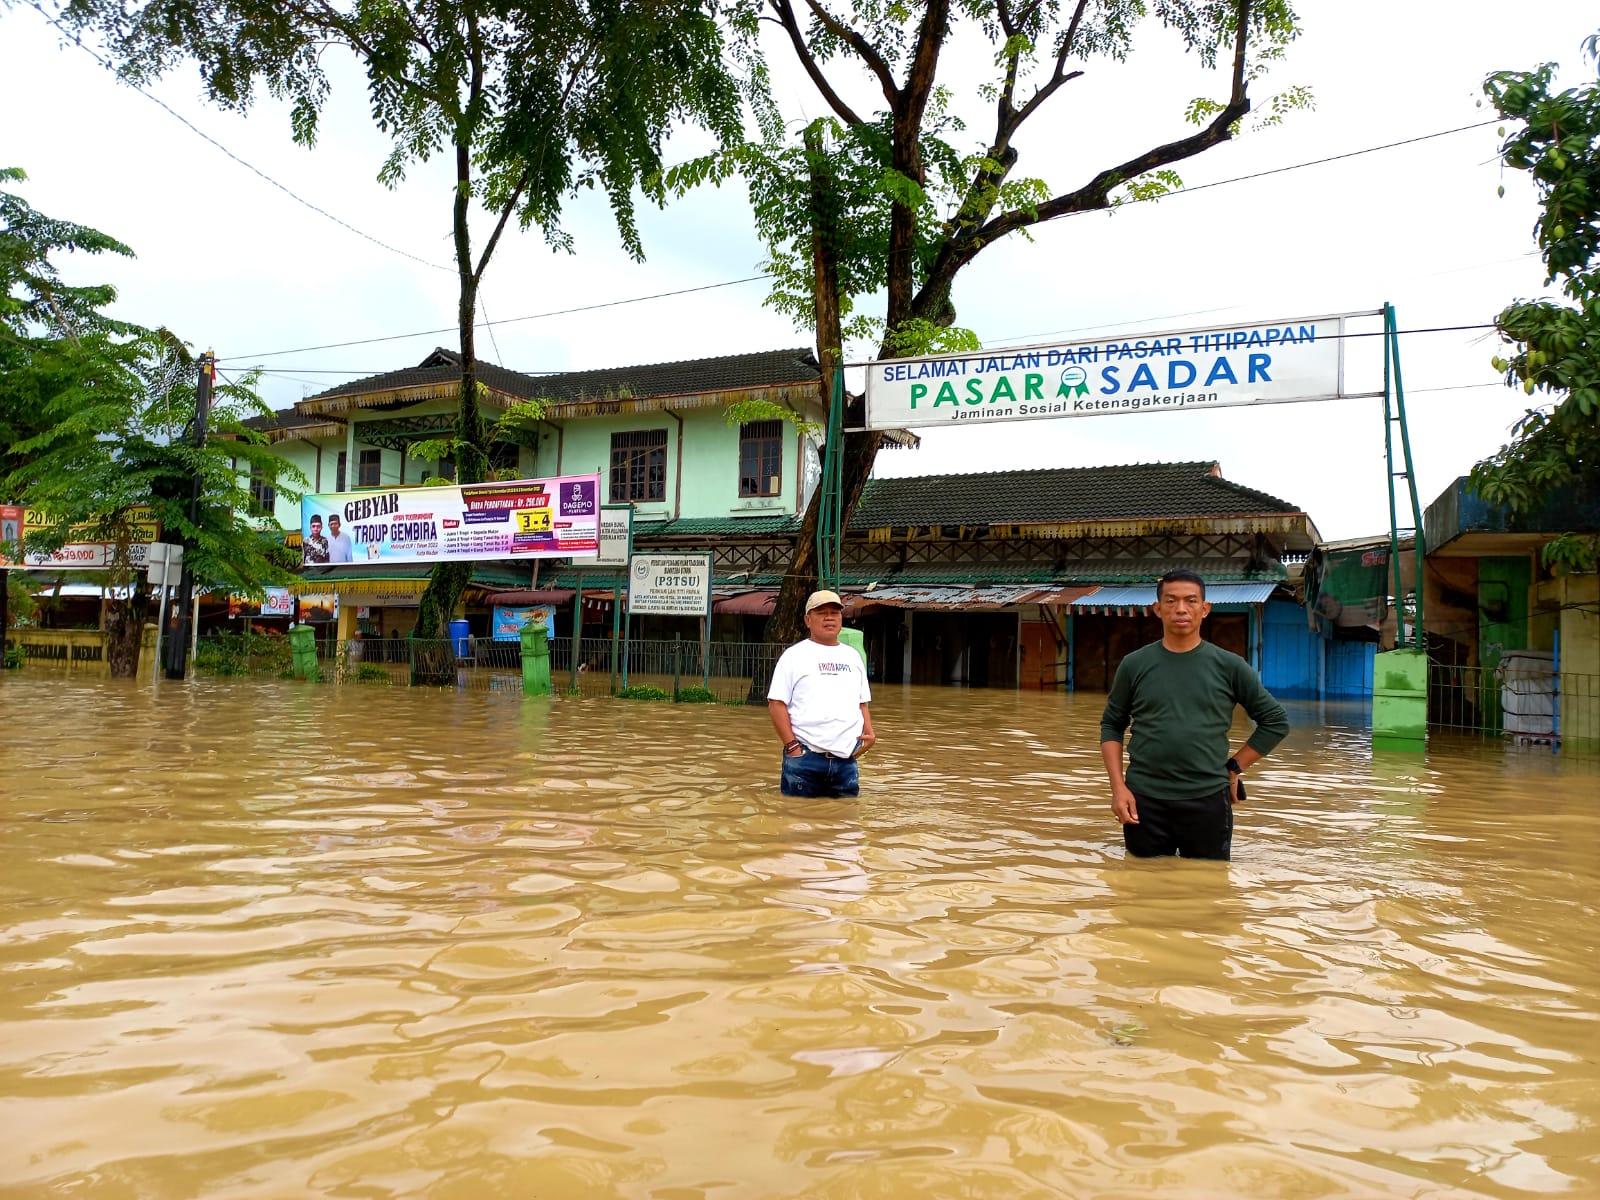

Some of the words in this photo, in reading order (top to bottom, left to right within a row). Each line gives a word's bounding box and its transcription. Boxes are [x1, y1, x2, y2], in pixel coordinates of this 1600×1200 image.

[884, 359, 967, 382] SELAMAT
[975, 352, 1040, 374] JALAN
[1048, 346, 1098, 367] DARI
[1106, 338, 1181, 361] PASAR
[1189, 325, 1316, 354] TITIPAPAN
[910, 372, 1044, 409] PASAR
[1100, 353, 1272, 395] SADAR
[952, 407, 1012, 420] Jaminan
[1019, 401, 1066, 415] Sosial
[1074, 391, 1218, 411] Ketenagakerjaan
[344, 493, 399, 522] GEBYAR
[563, 500, 592, 510] DAGEMO
[27, 511, 43, 525] 20
[523, 515, 530, 528] 3
[541, 514, 550, 527] 4
[353, 523, 388, 544] TROUP
[391, 521, 437, 541] GEMBIRA
[65, 550, 94, 560] 79.000
[655, 575, 700, 587] (P3TSU)
